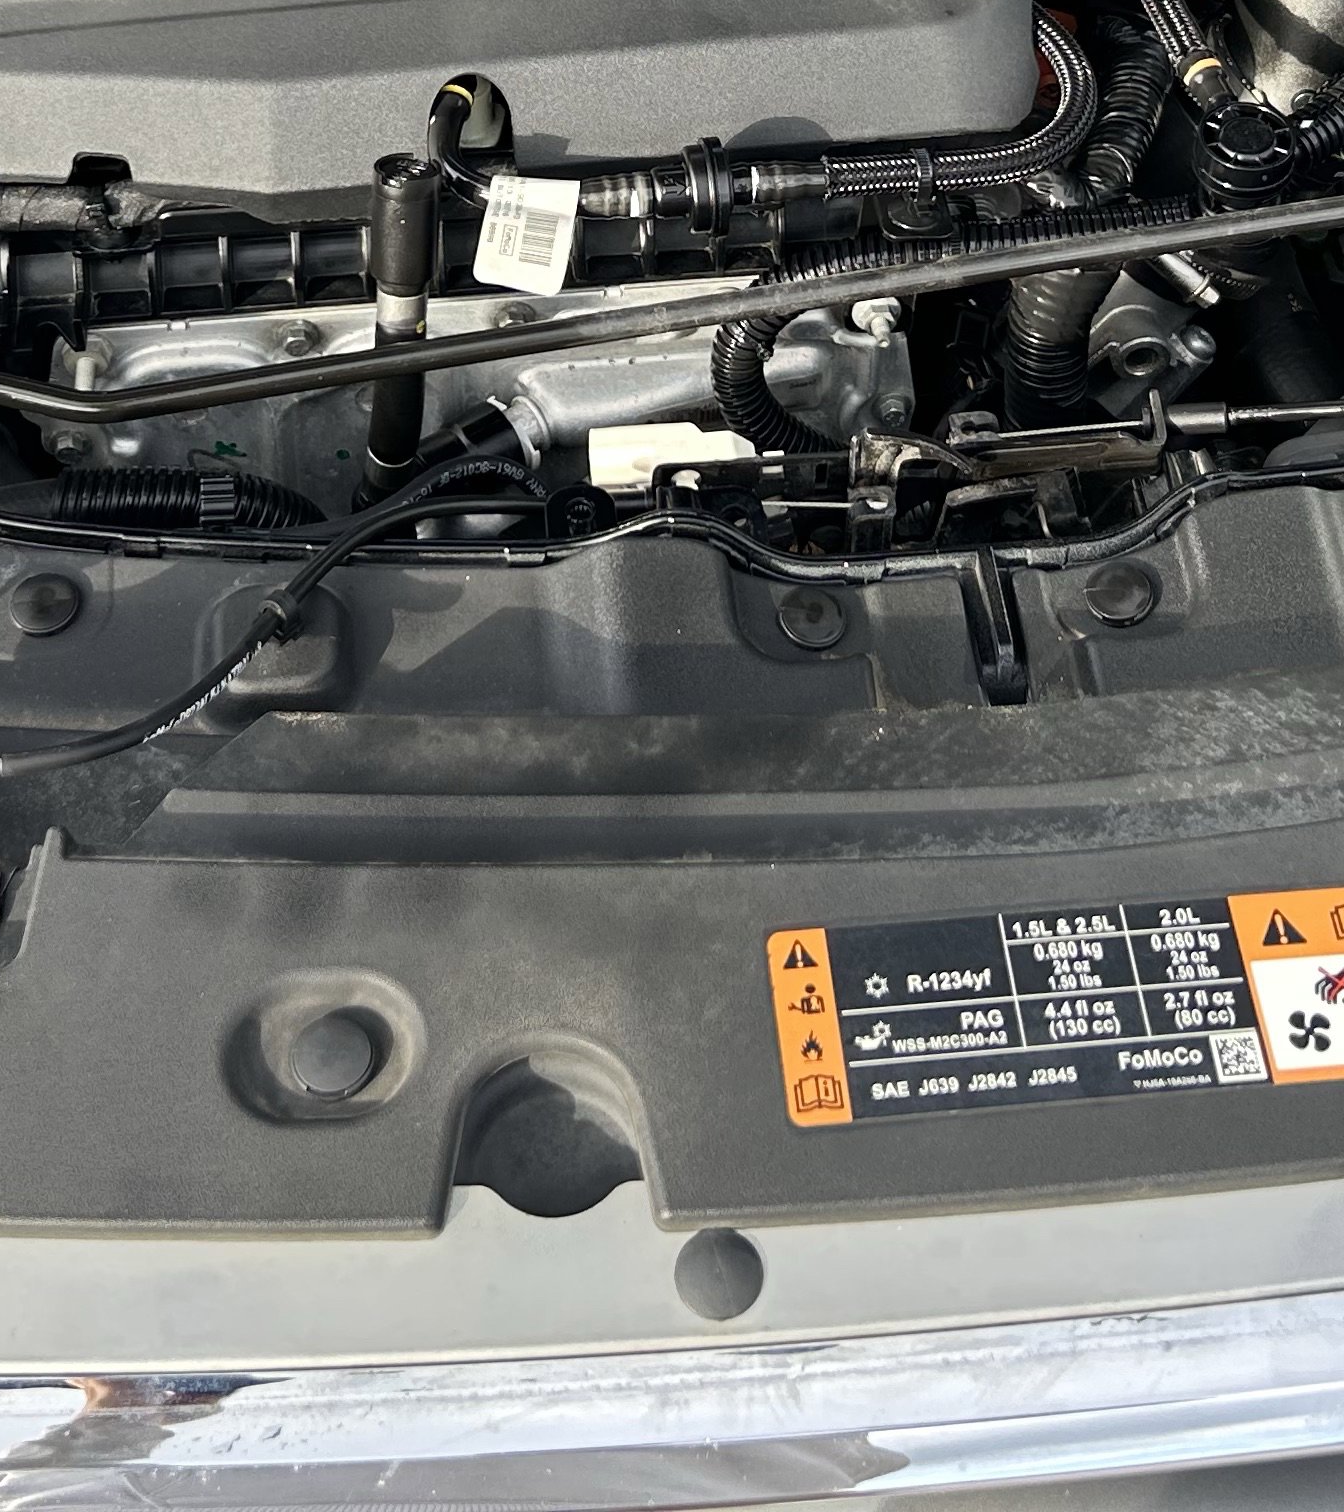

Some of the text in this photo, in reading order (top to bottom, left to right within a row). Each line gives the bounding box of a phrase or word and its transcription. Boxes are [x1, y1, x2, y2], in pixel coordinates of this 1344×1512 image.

[1012, 914, 1116, 938] 1.5L & 2.5L
[1159, 907, 1201, 927] 2.0L
[1033, 939, 1104, 961] 0.680 kg
[1150, 930, 1221, 952] 0.680 kg
[1052, 959, 1091, 975] 24 oz
[1170, 949, 1208, 966] 24 oz
[907, 967, 992, 993] R-1234yf
[1048, 973, 1103, 991] 1.50 lbs
[1166, 963, 1220, 981] 1.50 lbs
[1044, 999, 1116, 1019] 4.4 fl oz
[1163, 989, 1235, 1011] 2.7 fl oz
[960, 1008, 1005, 1030] PAG
[1049, 1015, 1122, 1041] (130 cc)
[1174, 1005, 1236, 1031] (80 cc)
[892, 1030, 1008, 1054] WSS-M2C300-A2
[1118, 1046, 1204, 1071] FoMoCo
[871, 1065, 1078, 1100] SAE J639 J2842 J2845
